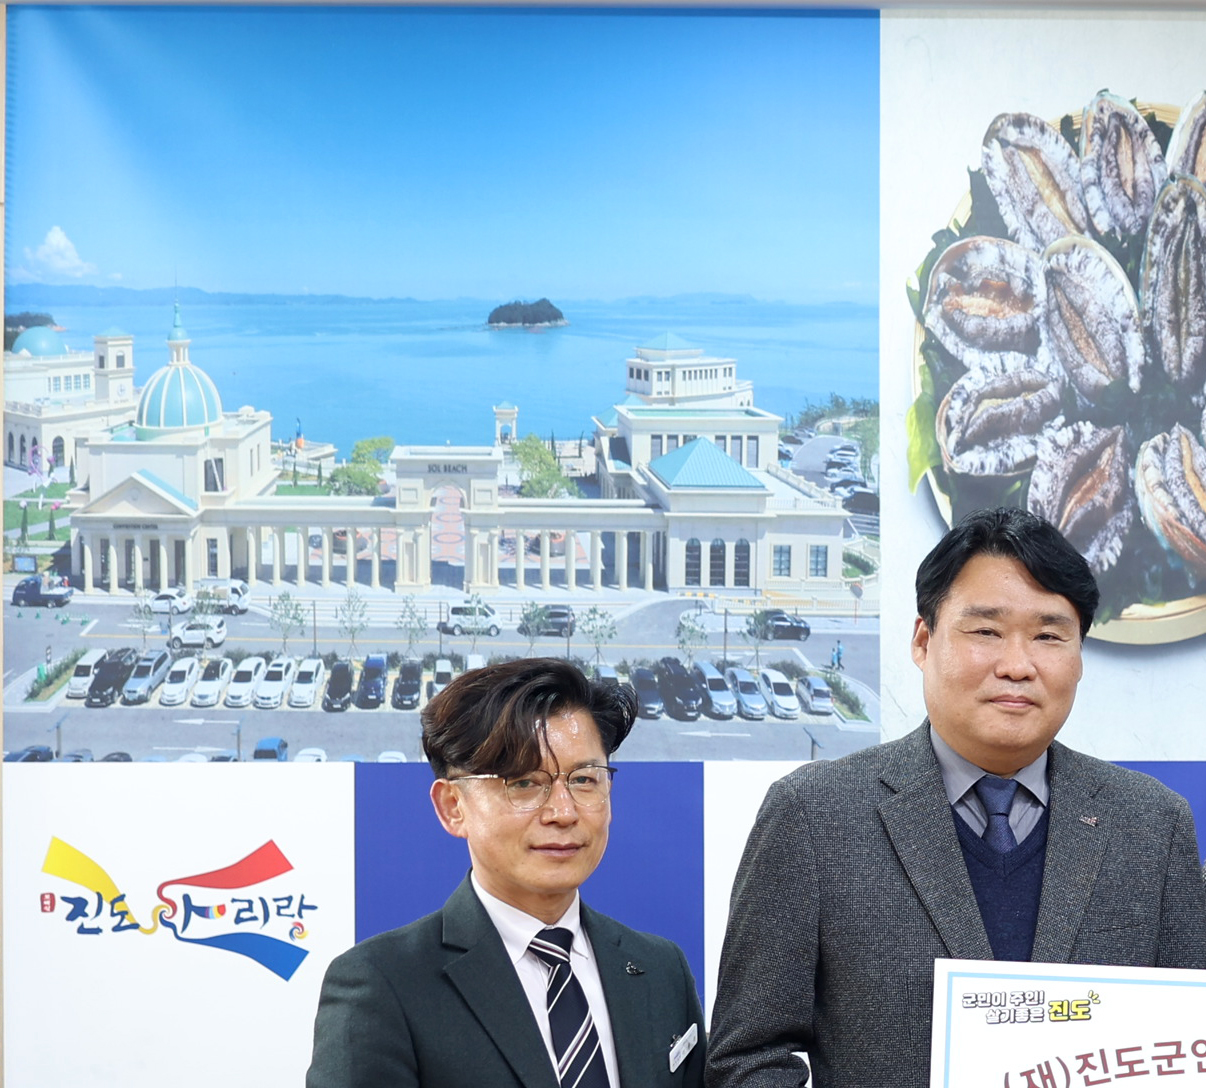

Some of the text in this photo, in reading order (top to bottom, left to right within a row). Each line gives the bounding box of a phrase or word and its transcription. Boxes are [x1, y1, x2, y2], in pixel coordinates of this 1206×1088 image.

[962, 990, 1045, 1008] 군민이 주인!
[985, 999, 1092, 1025] 살기좋은 진도
